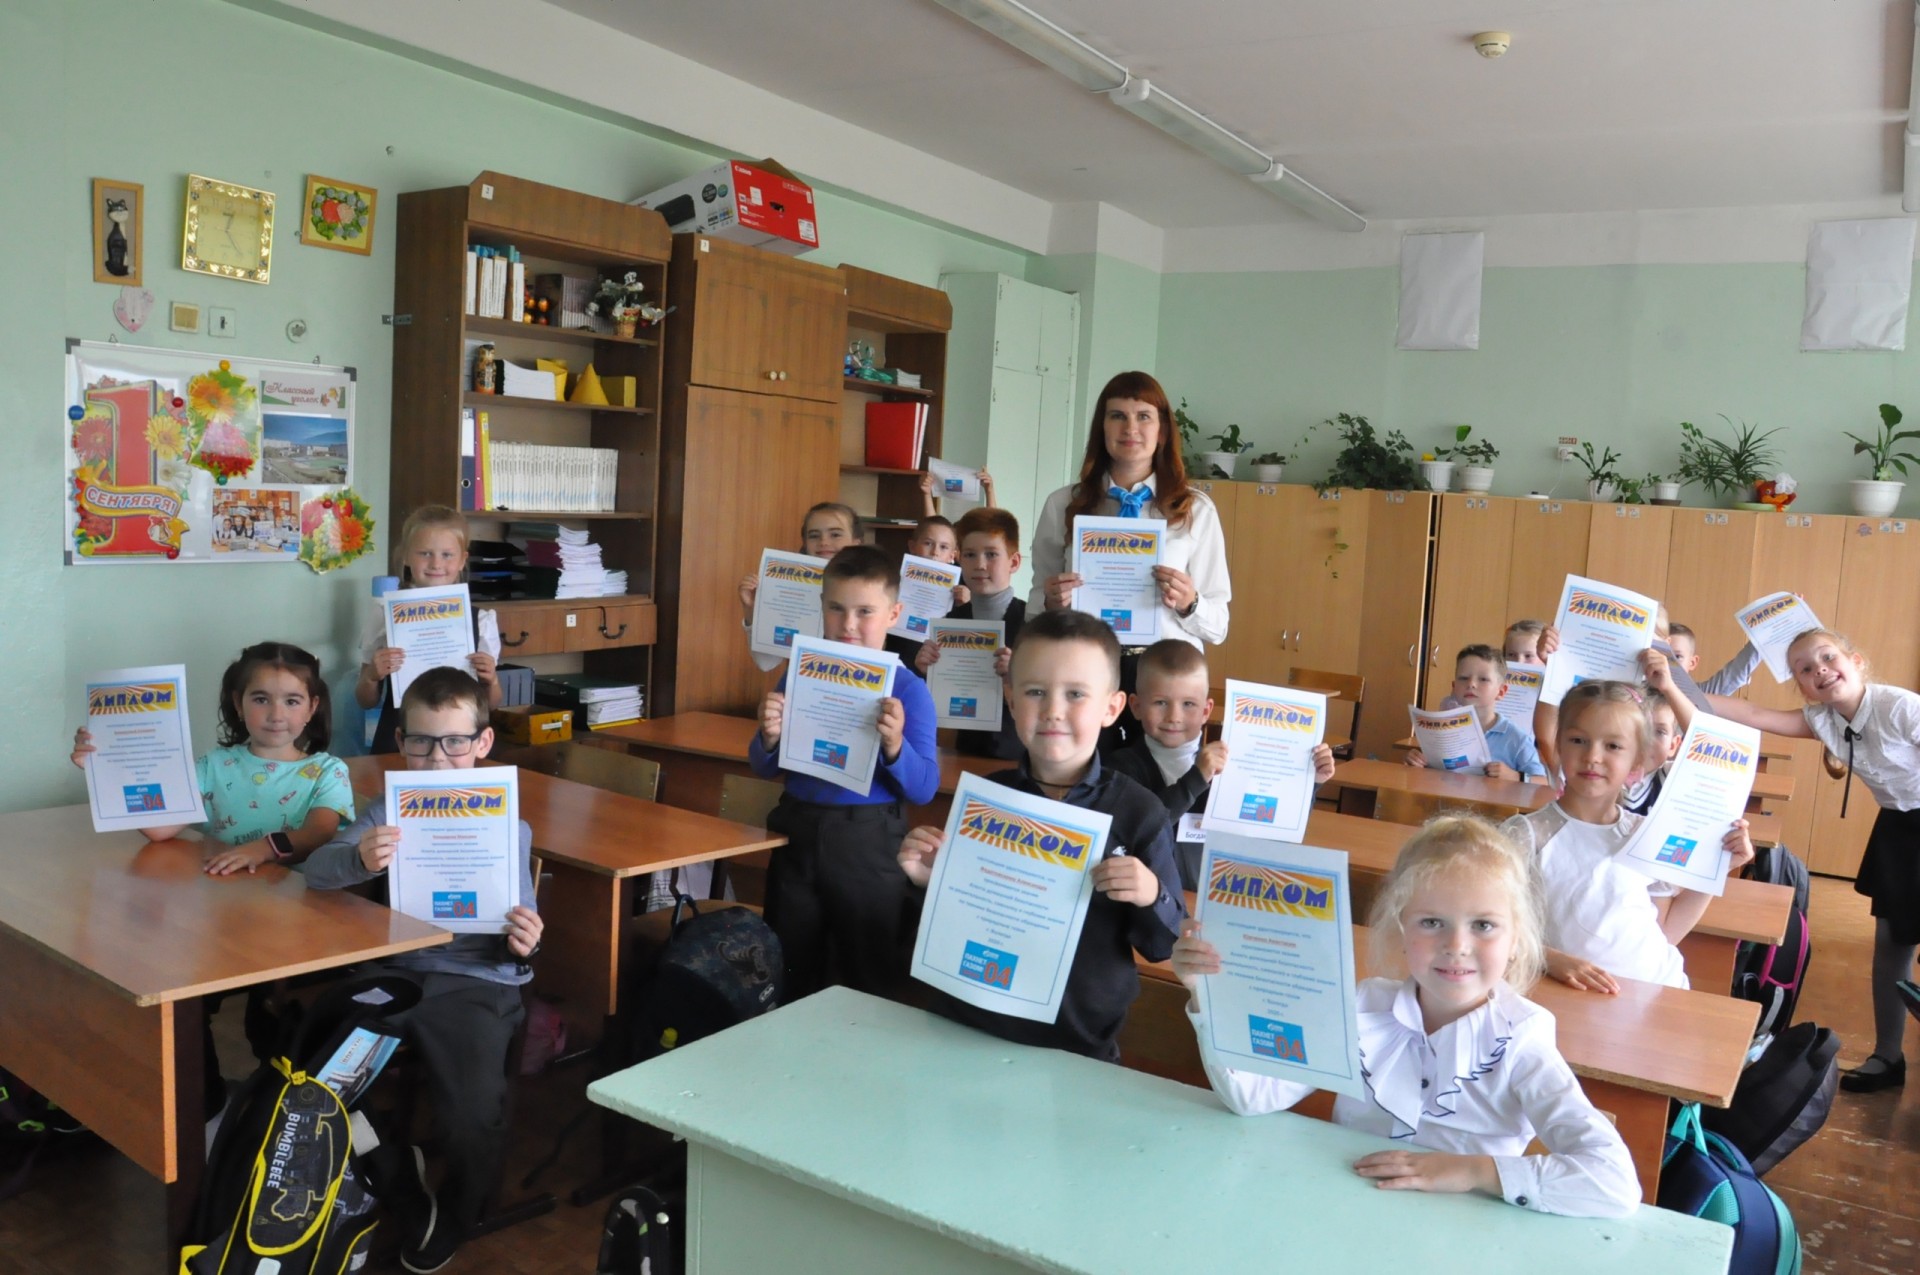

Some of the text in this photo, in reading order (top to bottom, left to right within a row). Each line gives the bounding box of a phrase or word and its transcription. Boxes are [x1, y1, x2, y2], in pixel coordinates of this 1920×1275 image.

[86, 485, 178, 514] СЕНТЯБРЯ!
[968, 813, 1085, 861] ДИПЛОМ
[1214, 873, 1328, 909] ДИПЛОМ
[983, 961, 1011, 987] 04
[1275, 1036, 1304, 1061] 04
[266, 1112, 301, 1189] BUMBLEBEE
